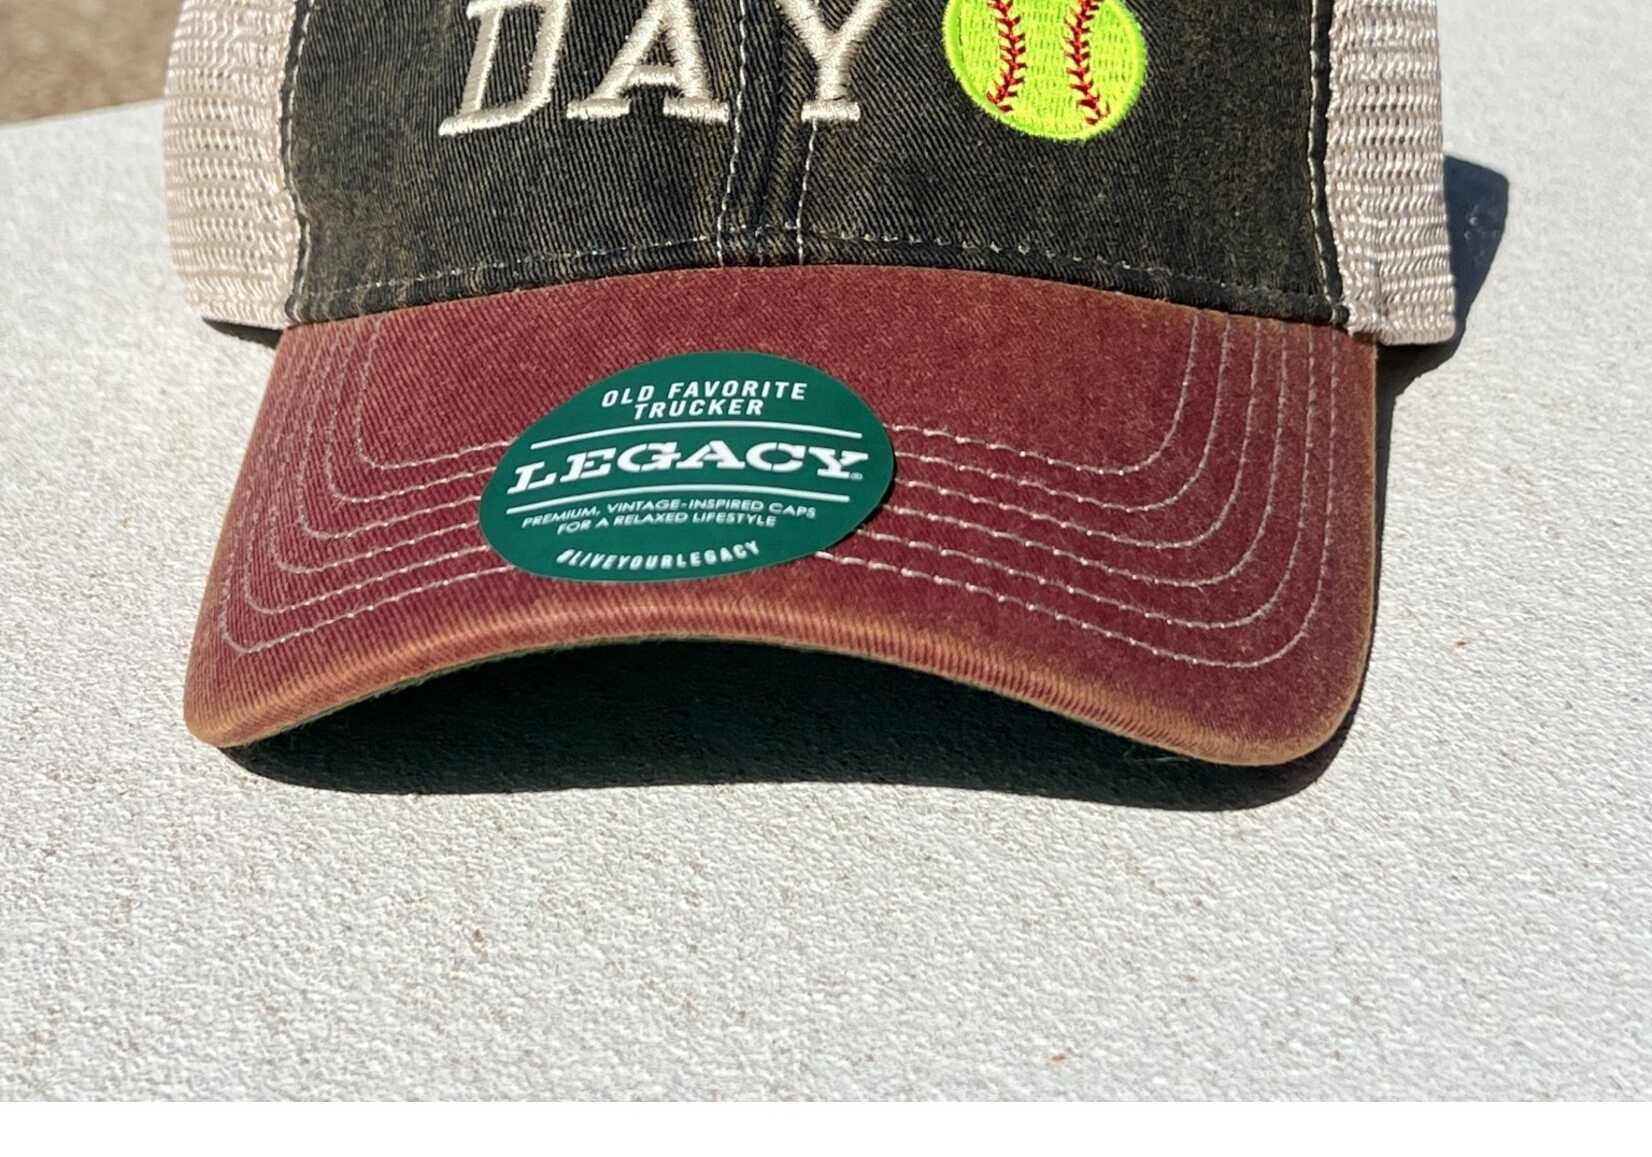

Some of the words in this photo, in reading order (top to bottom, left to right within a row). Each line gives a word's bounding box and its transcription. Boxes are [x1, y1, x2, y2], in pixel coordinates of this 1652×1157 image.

[601, 384, 655, 408] OLD
[667, 379, 808, 401] FAVORITE
[634, 398, 764, 420] TRUCKER
[522, 505, 601, 529] PREMIUM,
[607, 498, 764, 513] VINTAGE-INSPIRED
[768, 502, 817, 520] CAPS
[556, 520, 591, 535] FOR
[595, 517, 610, 528] A
[613, 512, 688, 526] RELAXED
[692, 511, 777, 528] LIFESTYLE
